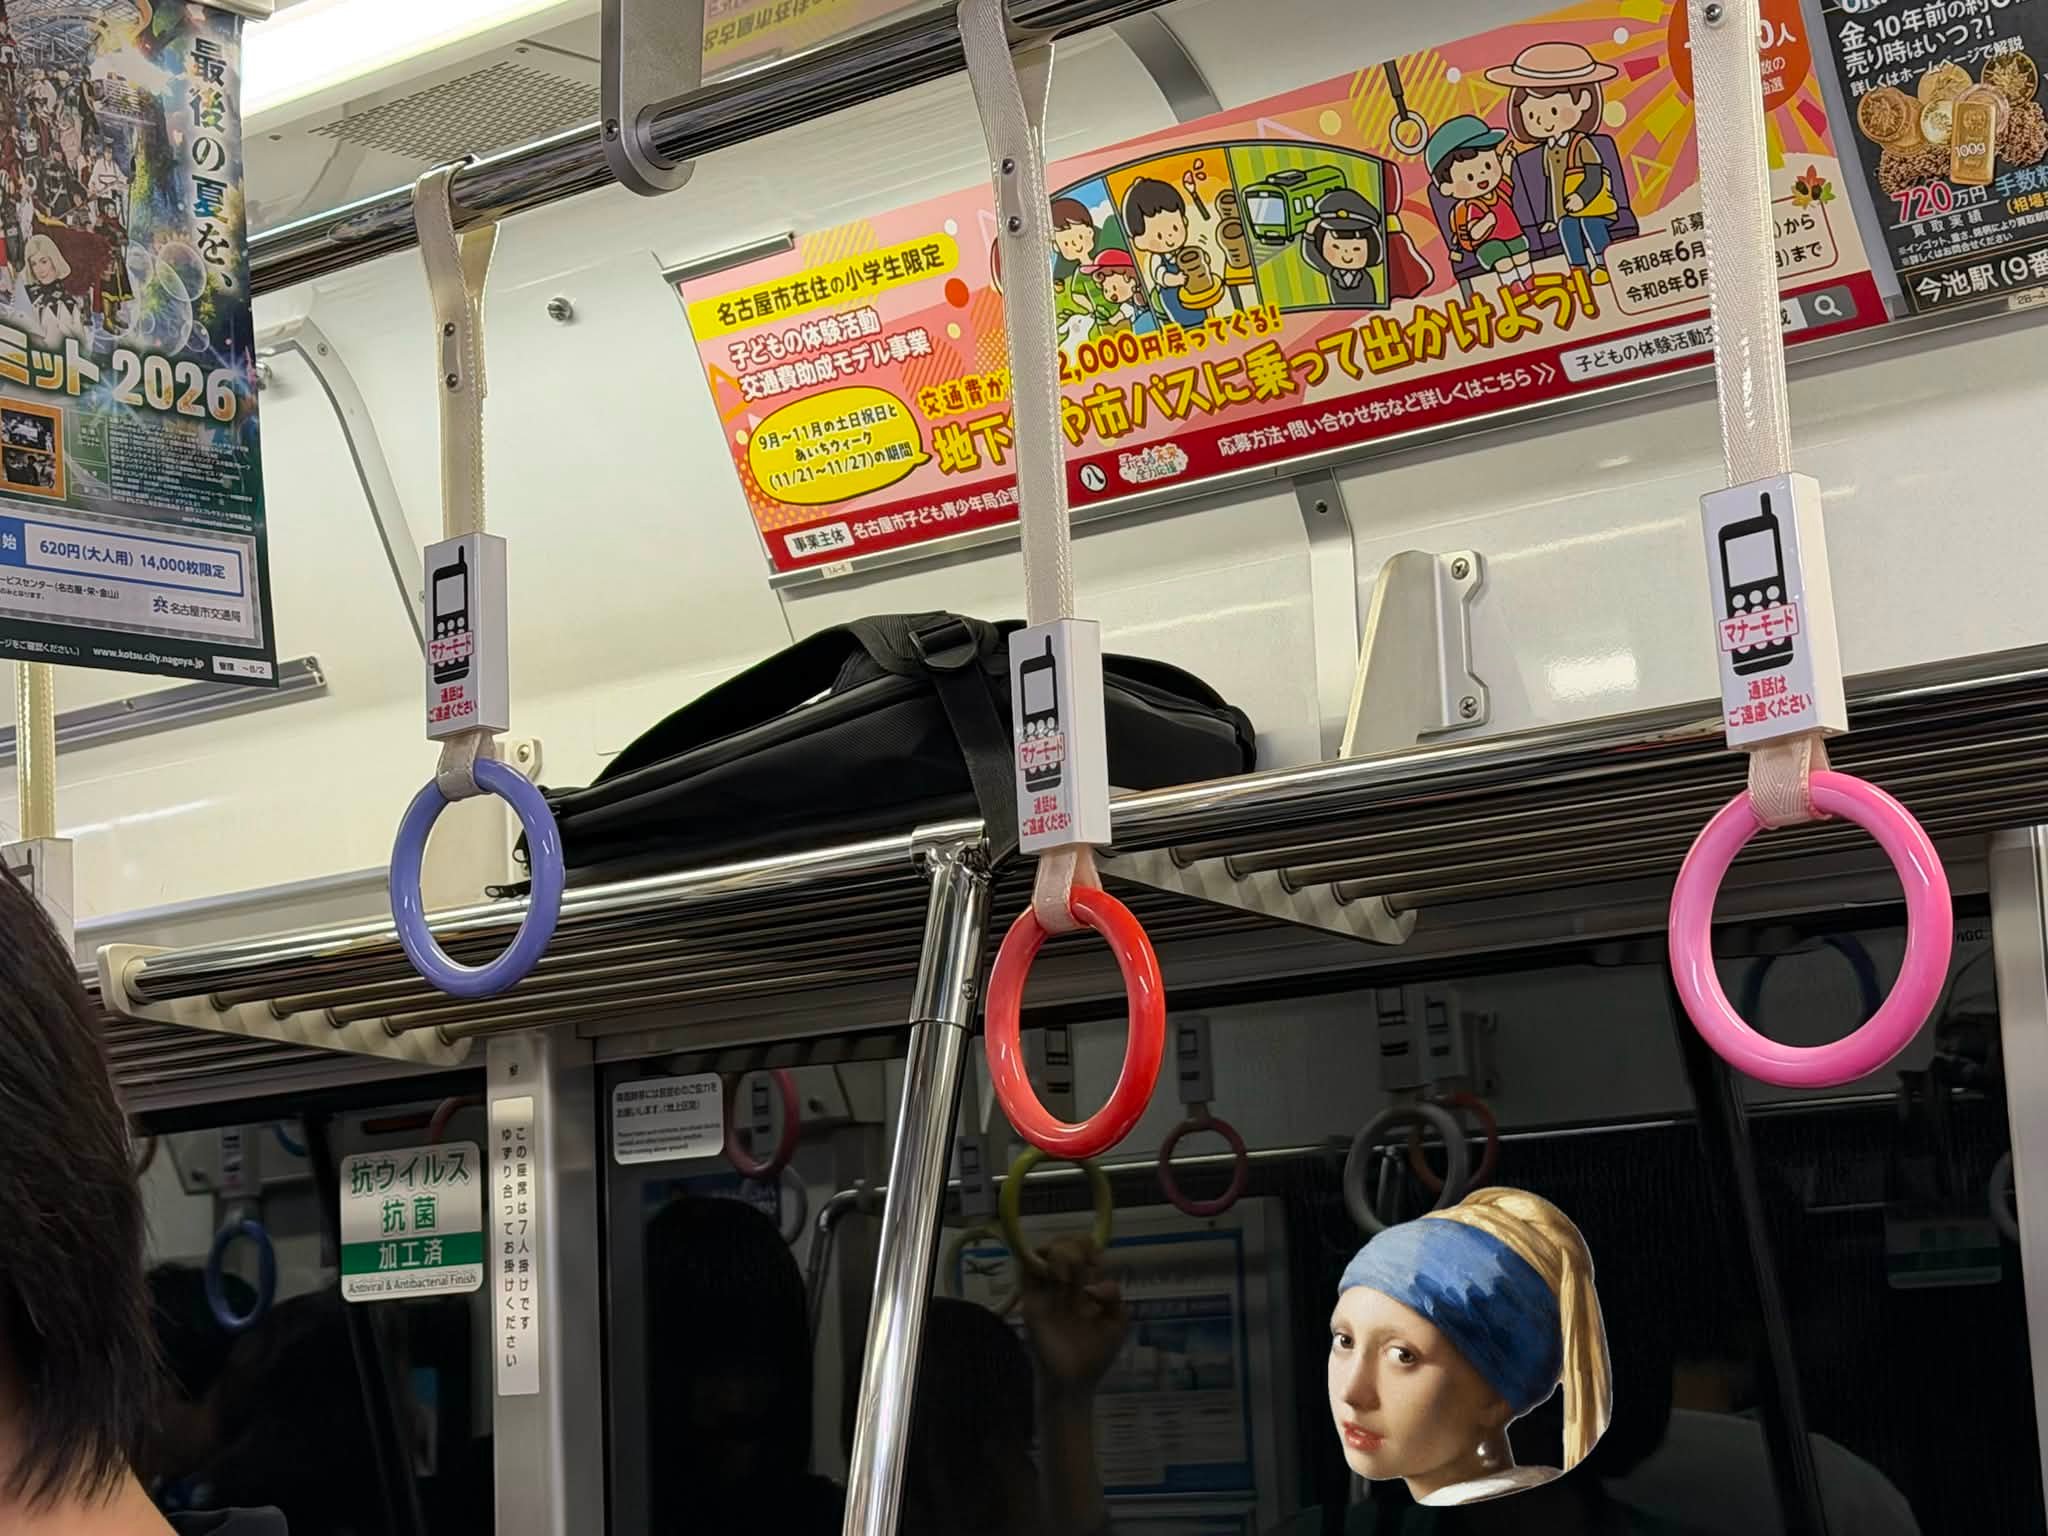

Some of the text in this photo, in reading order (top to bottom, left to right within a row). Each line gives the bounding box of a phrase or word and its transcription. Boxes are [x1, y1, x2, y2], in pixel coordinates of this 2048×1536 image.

[1839, 0, 2026, 52] 金、10年前の約
[1850, 35, 2024, 97] 詳しくはホームページで解説
[189, 37, 234, 288] 最後の夏を、
[1891, 181, 1988, 224] 720万円
[1671, 211, 1705, 237] 応募
[1912, 208, 1984, 238] 買取実績
[1617, 240, 1706, 277] 令和8年6月
[716, 243, 945, 327] 名古屋市在住の小学生限定
[728, 306, 881, 372] 子どもの体験活動
[739, 326, 933, 404] 交通費助成モデル事業
[111, 348, 238, 423] 2026
[1217, 366, 1533, 458] 応募方法・問い合わせ先など詳しくはこちら
[794, 433, 873, 463] あいちウィーク
[932, 405, 1014, 474] 地下
[791, 525, 847, 554] 事業主体
[39, 540, 226, 580] 620円(大人用) 14,000枚限定
[169, 602, 241, 623] 名古屋市交通局
[1723, 608, 1795, 644] マナーモード
[93, 647, 205, 670] www.kotsu.city.nagoya.jp
[430, 634, 472, 661] マナーモード
[1747, 675, 1788, 701] 通話は
[429, 699, 478, 724] ご遠慮ください
[1728, 693, 1813, 728] ご遠慮ください
[1022, 811, 1072, 837] ご遠慮ください
[351, 1151, 470, 1195] 抗ウイルス
[382, 1195, 437, 1234] 抗菌
[515, 1126, 531, 1331] この座席は7人掛けです
[379, 1238, 443, 1270] 加工済
[501, 1128, 518, 1369] ゆずり合ってお掛けください
[450, 1272, 476, 1285] Finish
